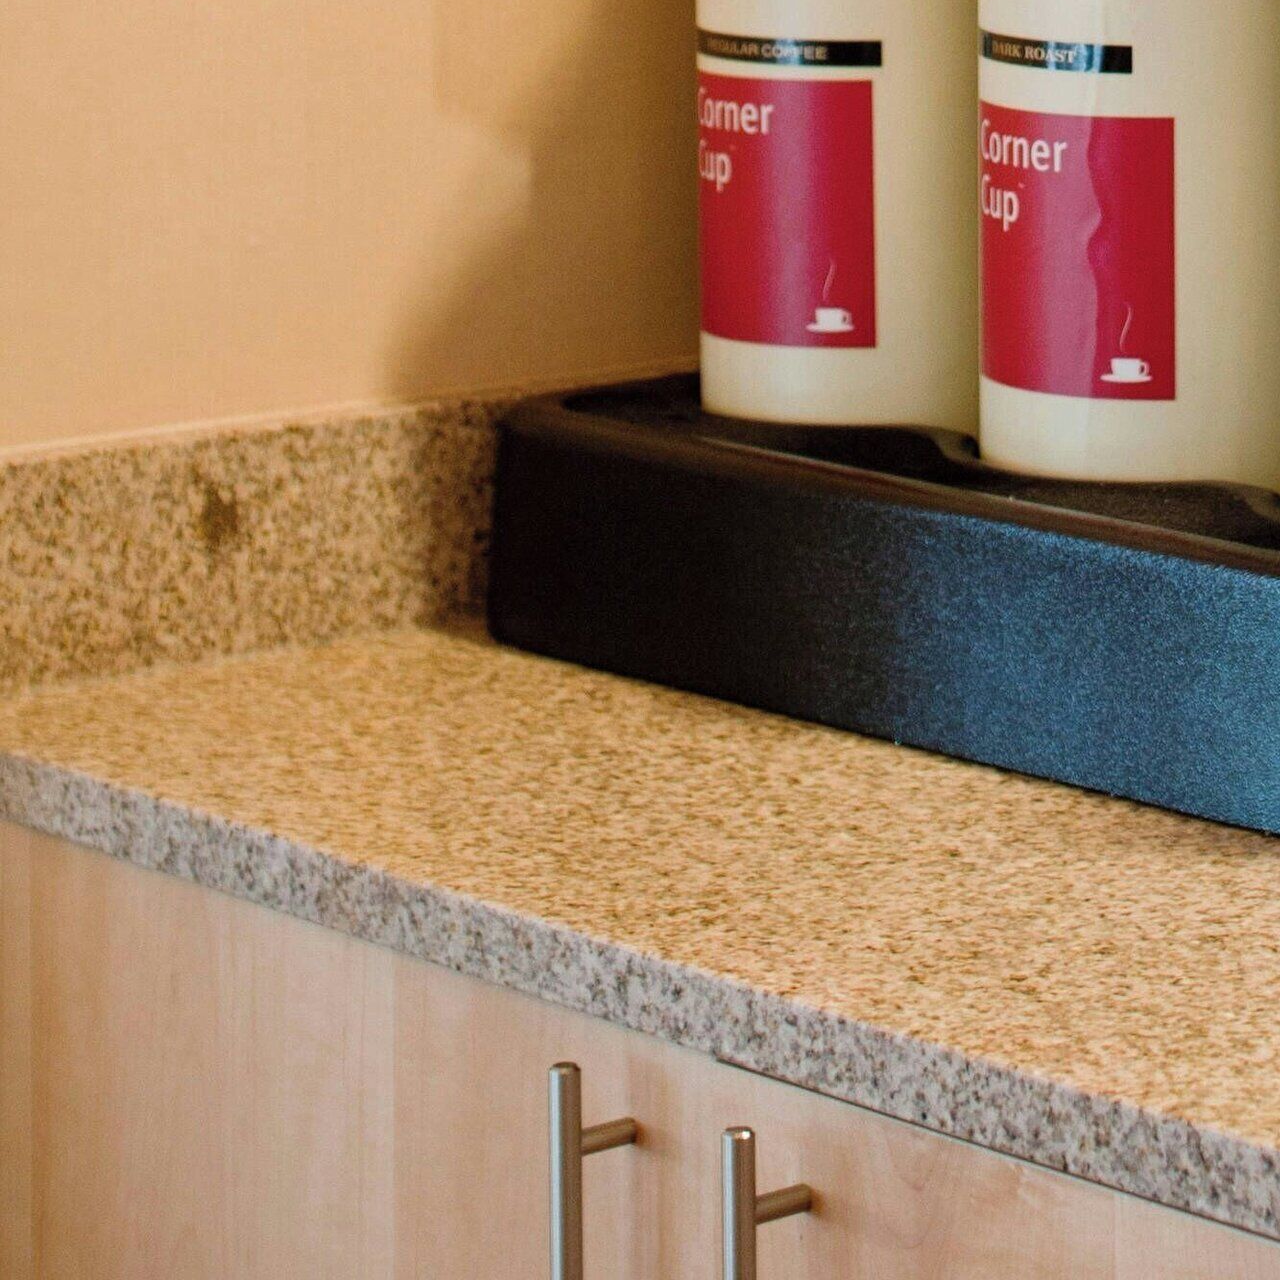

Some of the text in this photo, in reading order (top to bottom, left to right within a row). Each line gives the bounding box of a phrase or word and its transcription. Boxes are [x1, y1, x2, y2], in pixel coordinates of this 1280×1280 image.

[761, 42, 829, 61] COFFEE
[1024, 46, 1077, 64] ROAST
[980, 118, 1067, 173] Corner
[981, 174, 1020, 232] Cup
